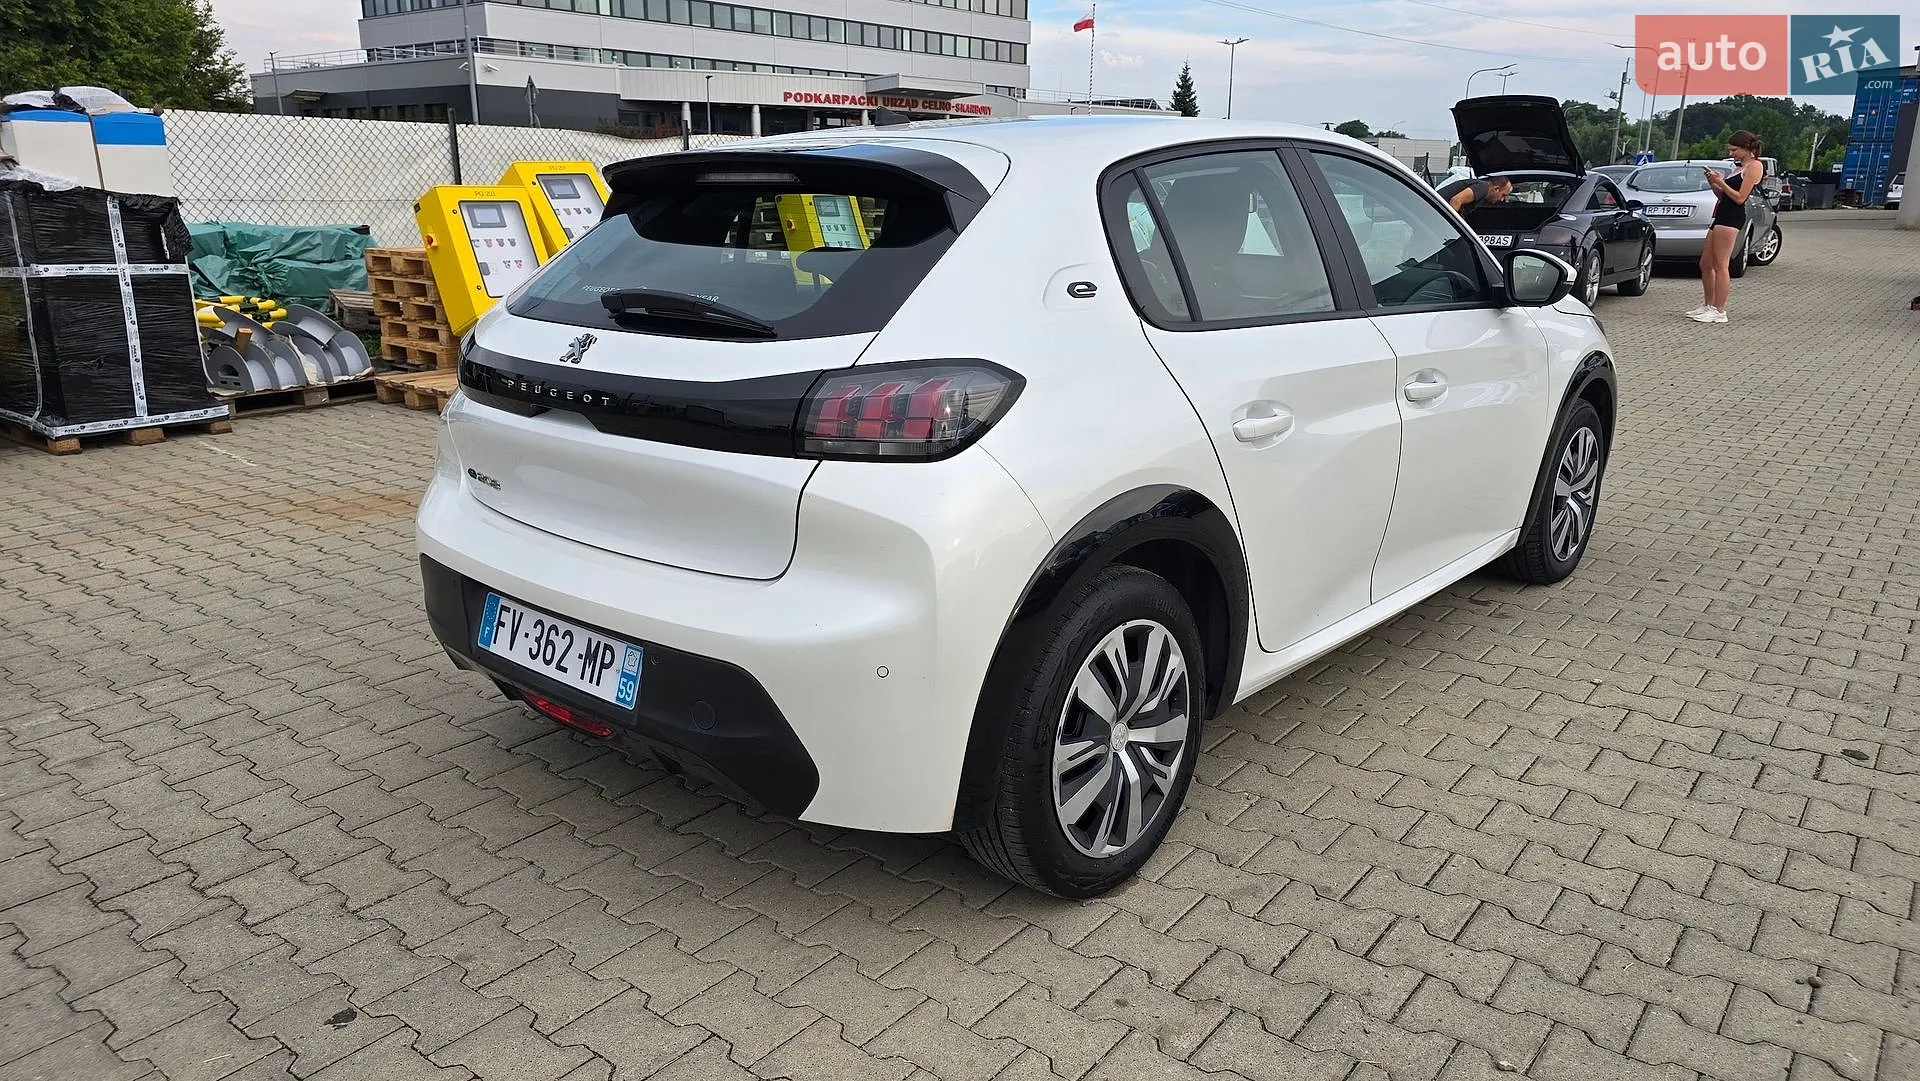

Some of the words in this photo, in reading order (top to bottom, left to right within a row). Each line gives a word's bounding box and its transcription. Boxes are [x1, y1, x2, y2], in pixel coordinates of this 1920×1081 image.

[783, 91, 879, 107] PODKARPACKI
[882, 96, 919, 111] URZĄD
[1067, 281, 1097, 298] e
[507, 379, 610, 406] PEUGEOT
[492, 604, 616, 687] FV-362-MP
[617, 677, 635, 701] 59
